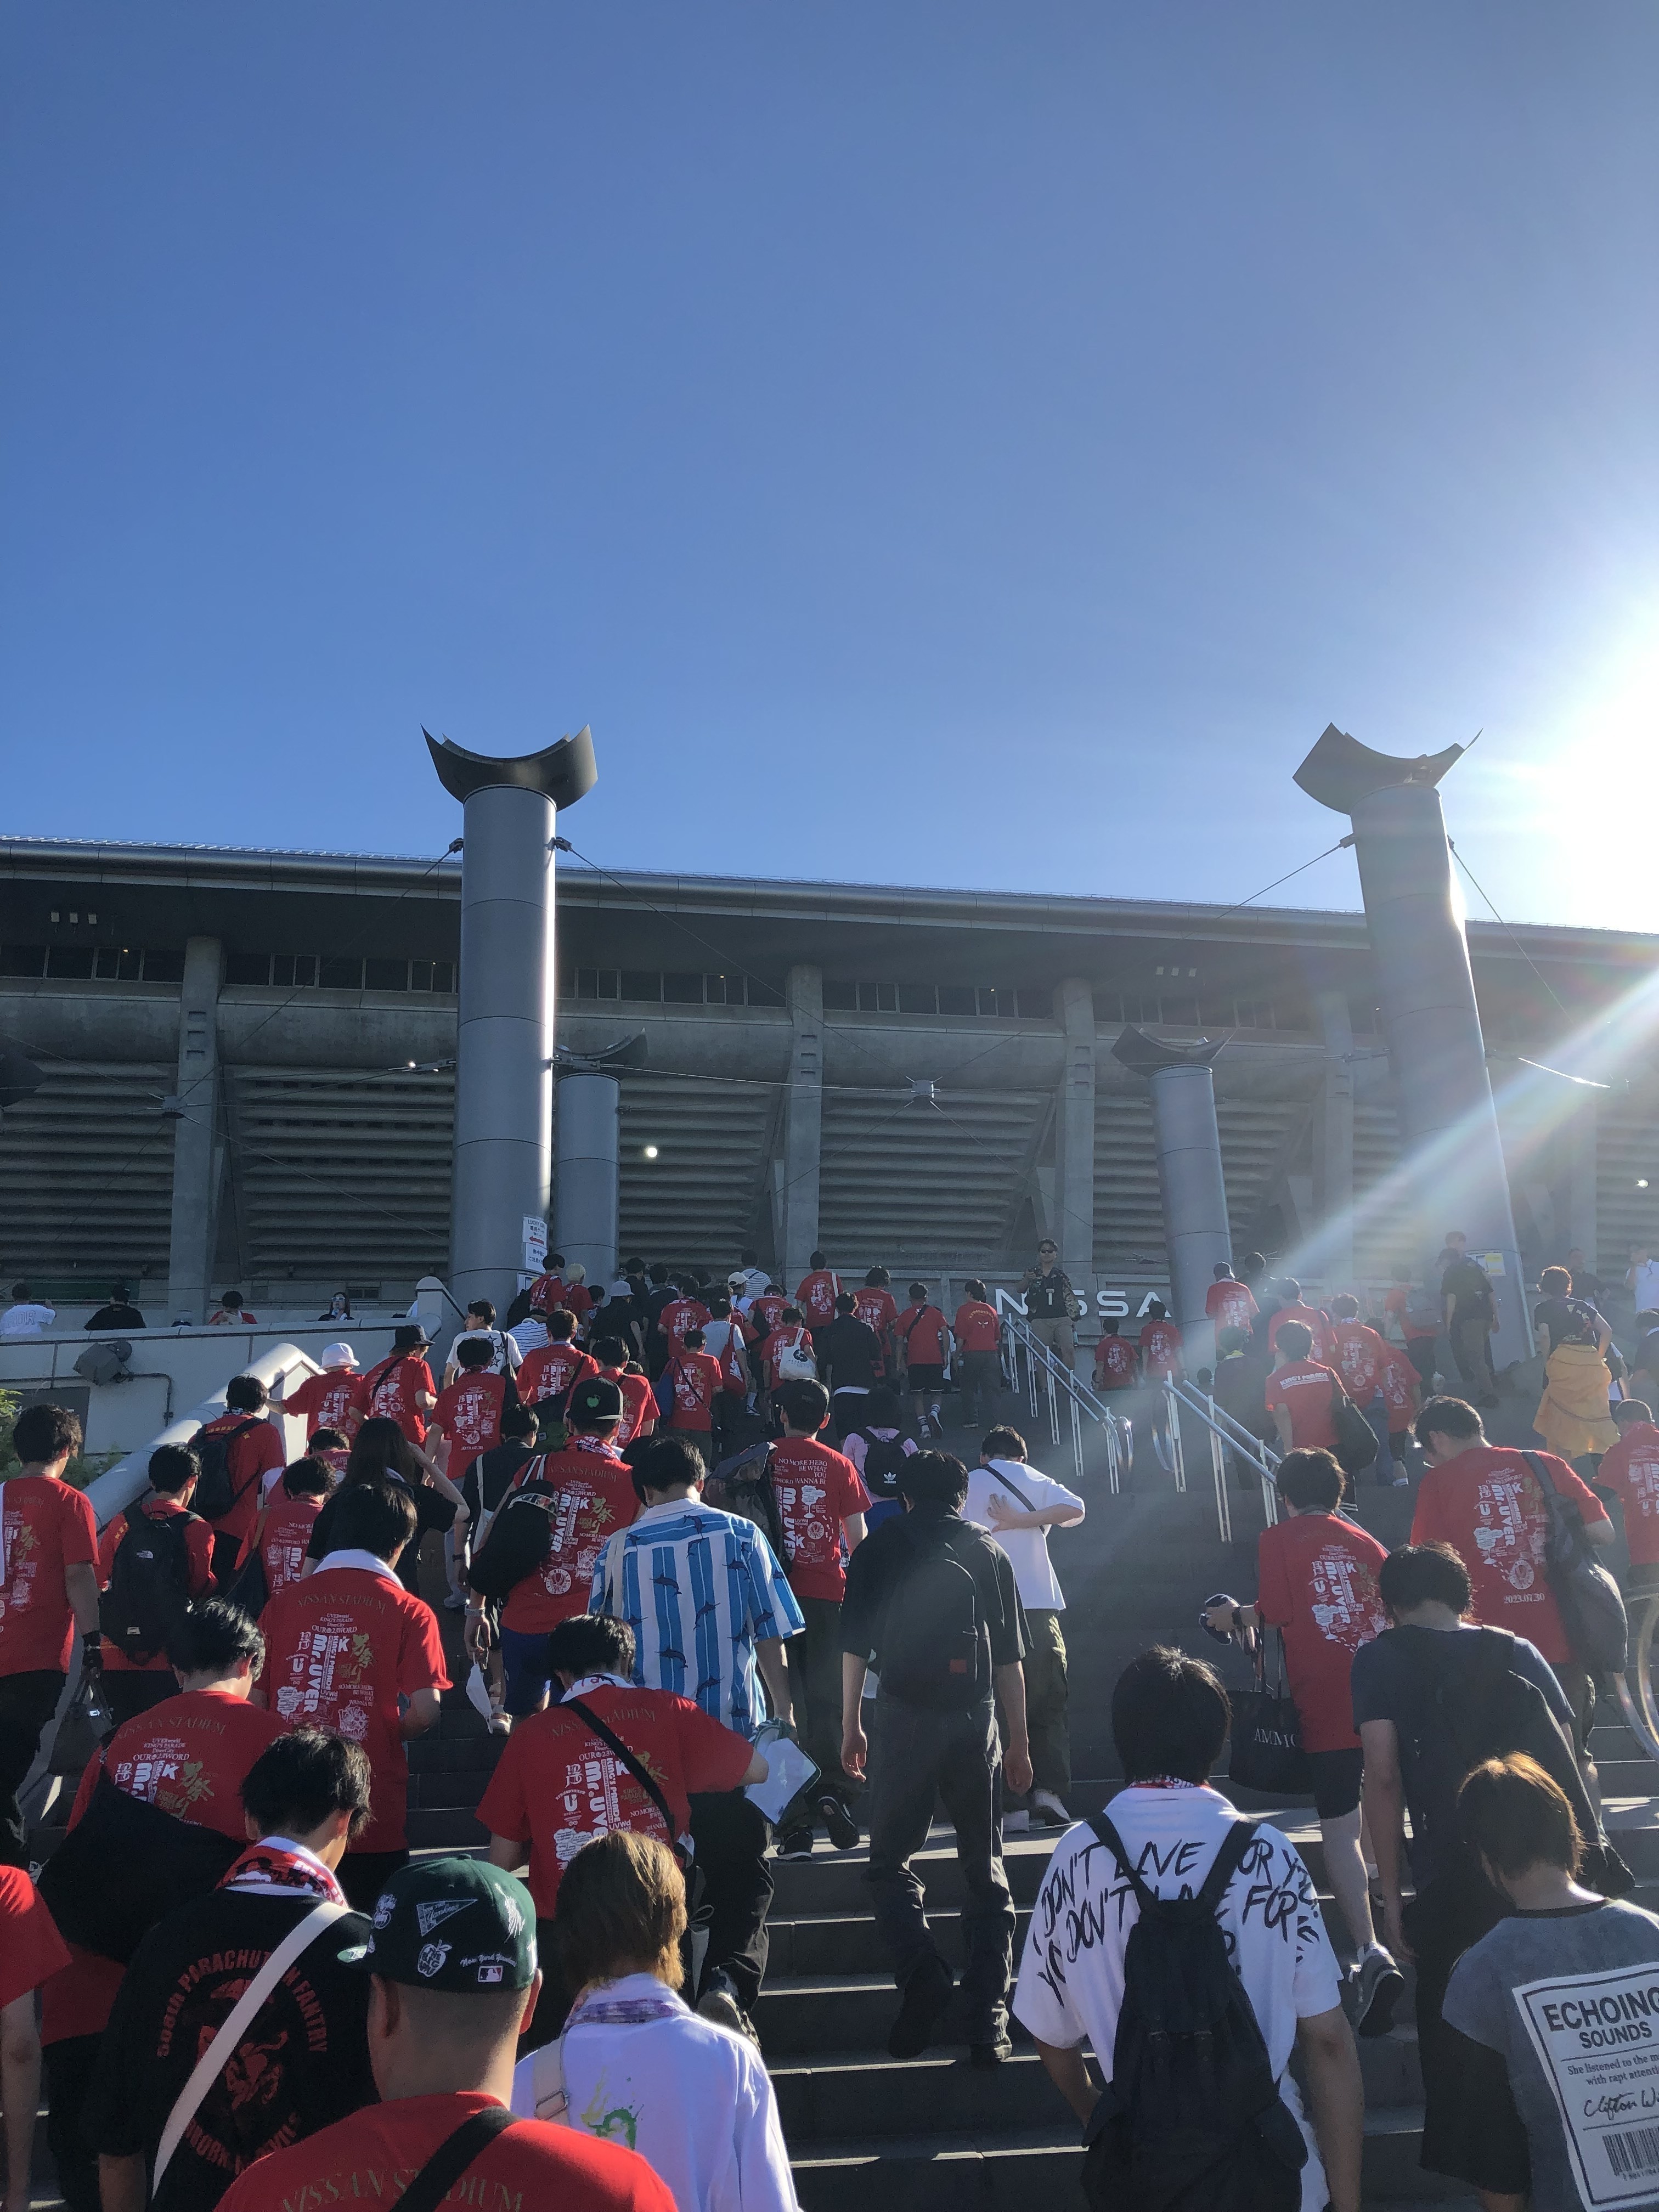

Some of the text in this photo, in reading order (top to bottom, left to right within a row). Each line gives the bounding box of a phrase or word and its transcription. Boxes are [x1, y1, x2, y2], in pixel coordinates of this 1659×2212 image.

[550, 1493, 572, 1553] Mr.UVER
[1491, 1484, 1516, 1547] Mr.UVER
[1324, 1561, 1351, 1624] Mr.UVER
[1504, 1593, 1545, 1604] 2023.07.30
[303, 1633, 328, 1712] Mr.UVER
[579, 1752, 596, 1762] OUR
[584, 1760, 608, 1837] Mr.UVE
[609, 1820, 631, 1830] UVWd
[1041, 1841, 1106, 1939] DON'T
[1237, 1838, 1274, 1889] OR
[1066, 1884, 1137, 1963] DON'T
[1242, 1884, 1298, 1944] FOR
[177, 1949, 273, 1993] PARACHUT
[1579, 2021, 1652, 2049] SOUNDS
[1568, 2054, 1659, 2076] She listened to the m
[1586, 2066, 1659, 2085] with rapt attenti
[1584, 2087, 1659, 2121] Clifton W
[394, 2169, 524, 2212] STDIUM
